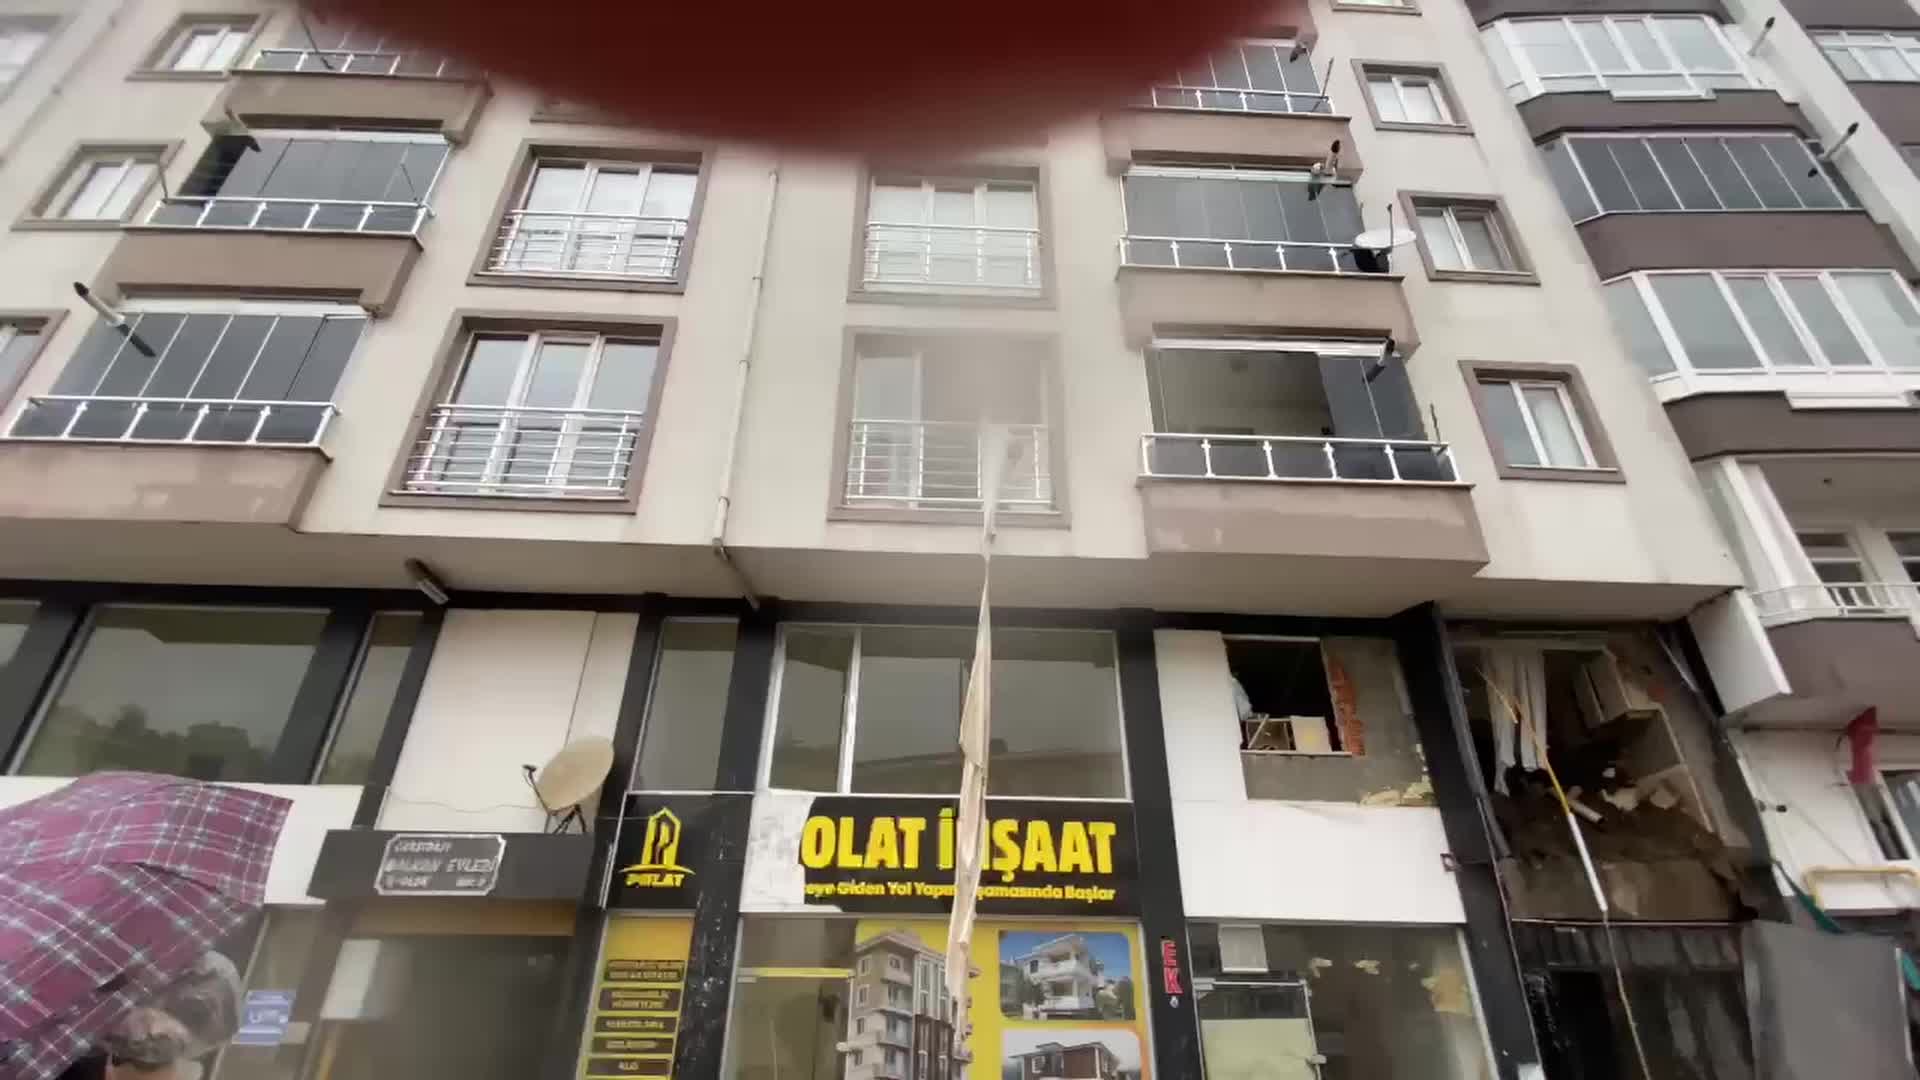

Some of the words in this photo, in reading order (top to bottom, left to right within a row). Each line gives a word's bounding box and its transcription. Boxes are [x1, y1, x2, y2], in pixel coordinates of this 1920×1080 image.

[801, 815, 927, 870] OLAT
[804, 884, 835, 898] eye
[837, 880, 885, 895] Giden
[888, 881, 912, 895] Yol
[976, 886, 1063, 900] şamasında
[1064, 886, 1116, 903] Başlar
